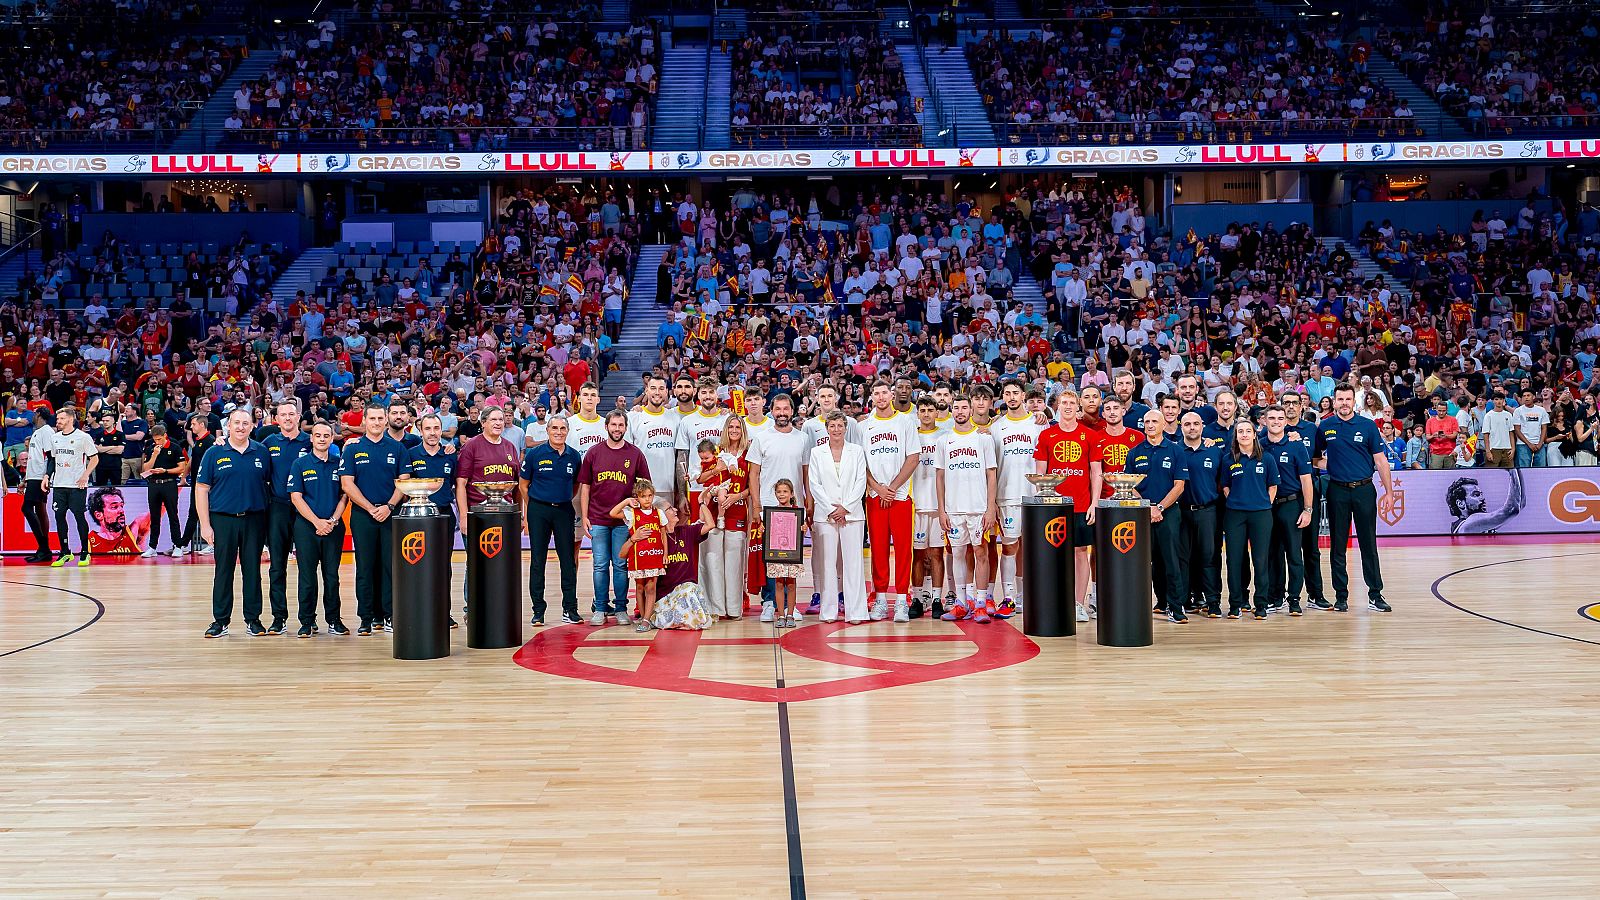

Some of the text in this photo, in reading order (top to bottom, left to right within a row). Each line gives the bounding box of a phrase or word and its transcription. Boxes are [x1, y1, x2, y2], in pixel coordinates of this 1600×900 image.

[1057, 149, 1159, 163] GRACIAS
[1201, 145, 1292, 163] LLULL
[1402, 143, 1504, 158] GRACIAS
[1546, 140, 1600, 158] LLU
[2, 158, 107, 171] GRACIAS
[151, 155, 244, 173] LLULL
[357, 156, 461, 170] GRACIAS
[505, 153, 597, 171] LLULL
[708, 153, 812, 167] GRACIAS
[854, 150, 946, 167] LLULL
[648, 427, 673, 439] ESPAÑA
[870, 432, 898, 445] ESPAÑA
[1003, 433, 1032, 446] ESPAÑA
[647, 441, 674, 449] endesa
[816, 437, 829, 446] ESP
[870, 446, 899, 456] endesa
[921, 445, 936, 454] PAÑ
[949, 446, 978, 460] ESPAÑA
[1003, 447, 1033, 456] endesa
[483, 463, 513, 477] ESPAÑA
[949, 460, 981, 470] endesa
[597, 470, 628, 484] ESPAÑA
[638, 548, 664, 557] endesa
[667, 551, 689, 563] PAÑA
